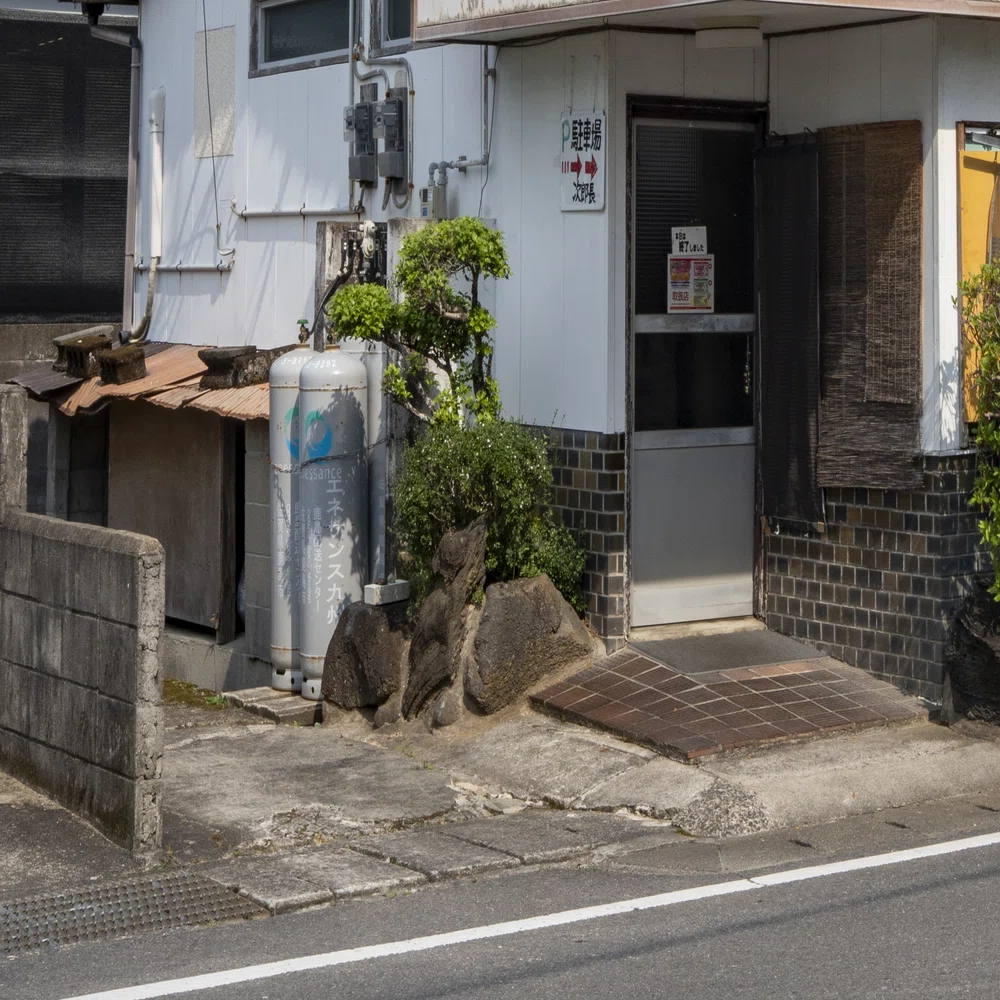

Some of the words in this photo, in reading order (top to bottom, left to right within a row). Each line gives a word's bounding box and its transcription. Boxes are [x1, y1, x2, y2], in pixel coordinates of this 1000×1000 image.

[562, 119, 571, 153] P
[571, 117, 602, 152] 駐車場
[572, 180, 596, 204] 次郎長
[678, 241, 705, 253] 終了しました
